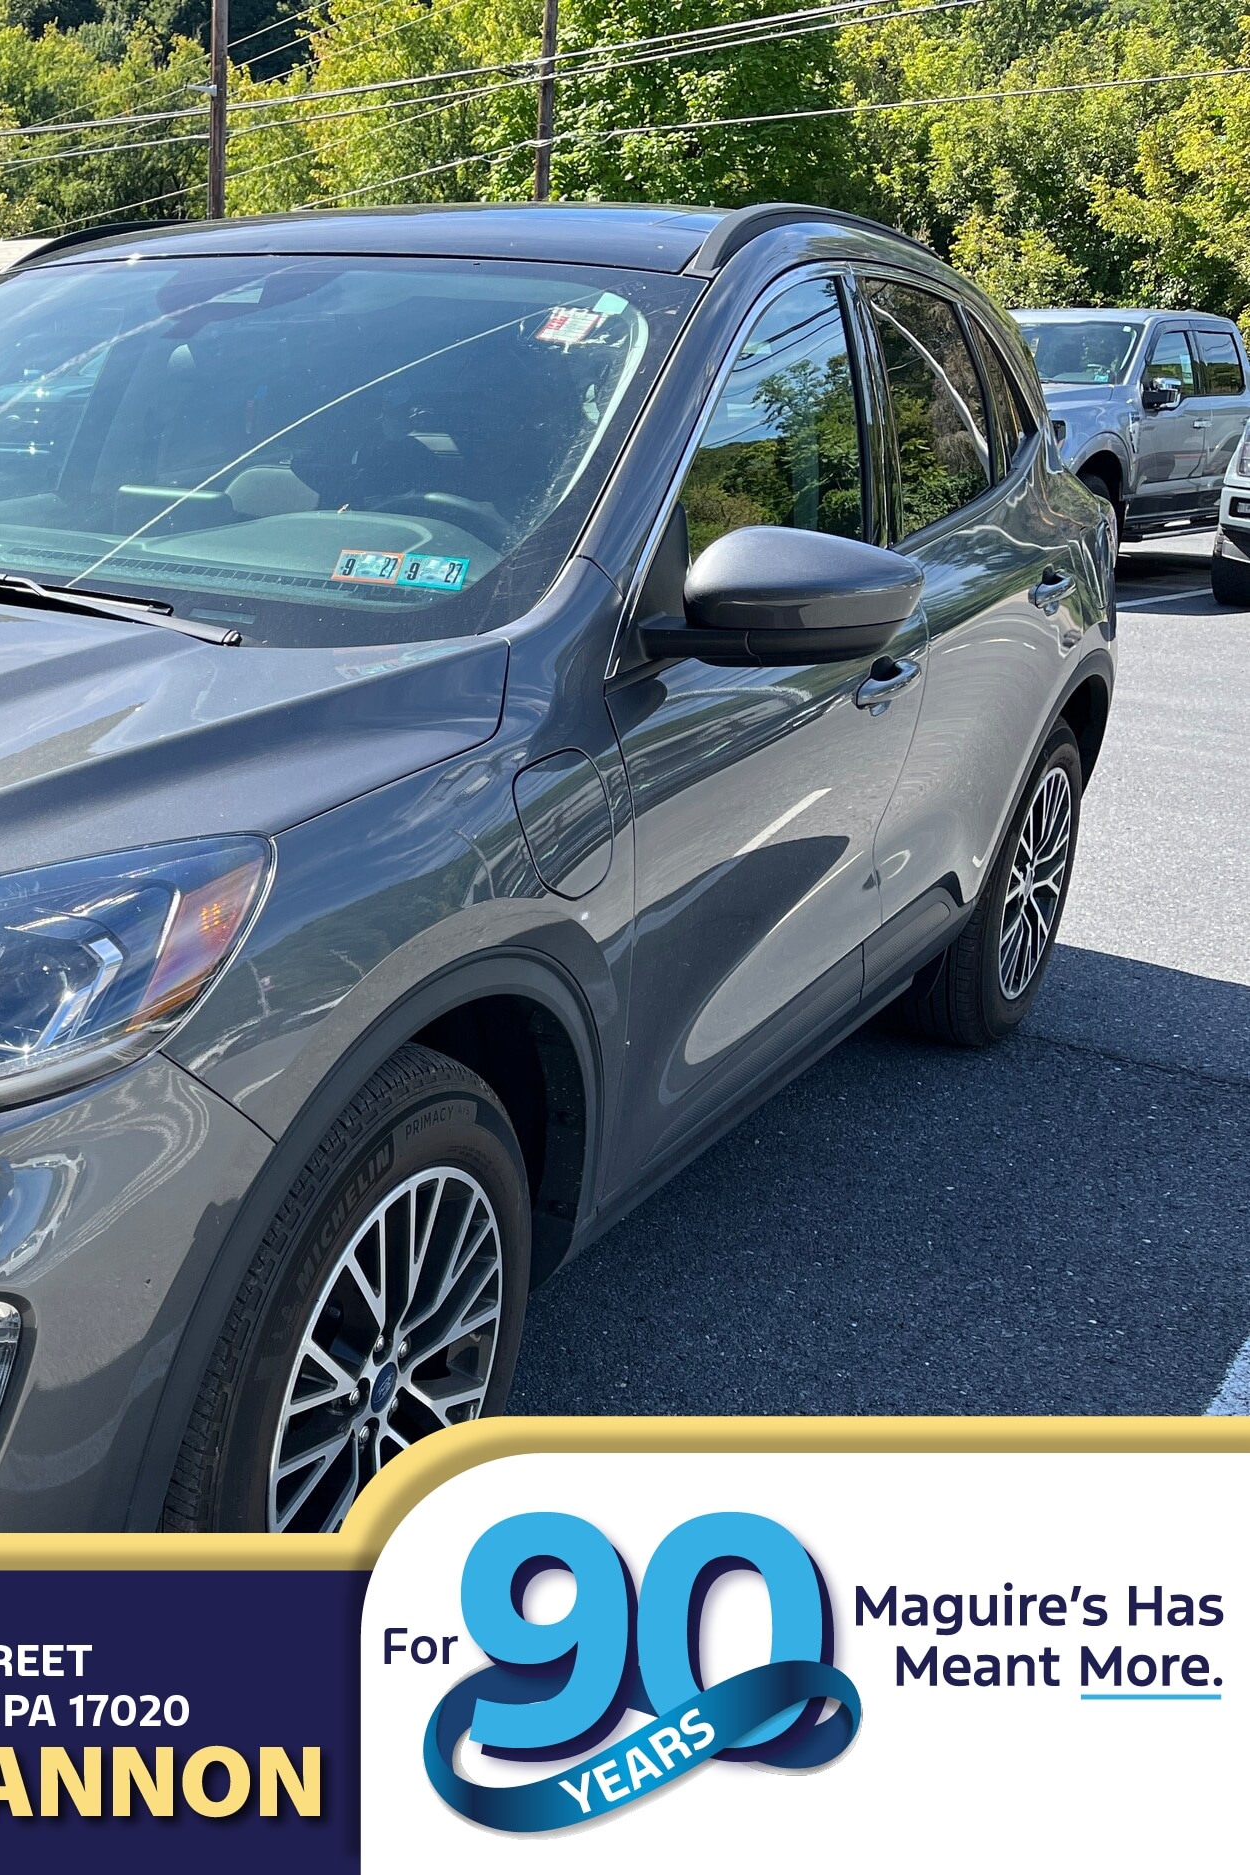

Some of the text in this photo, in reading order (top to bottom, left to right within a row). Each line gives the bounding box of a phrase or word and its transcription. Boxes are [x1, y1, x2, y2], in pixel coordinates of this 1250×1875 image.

[342, 556, 399, 580] 9 27
[406, 562, 464, 585] 9 27
[405, 1105, 454, 1140] PRIMACY
[296, 1142, 391, 1296] MICHELIN
